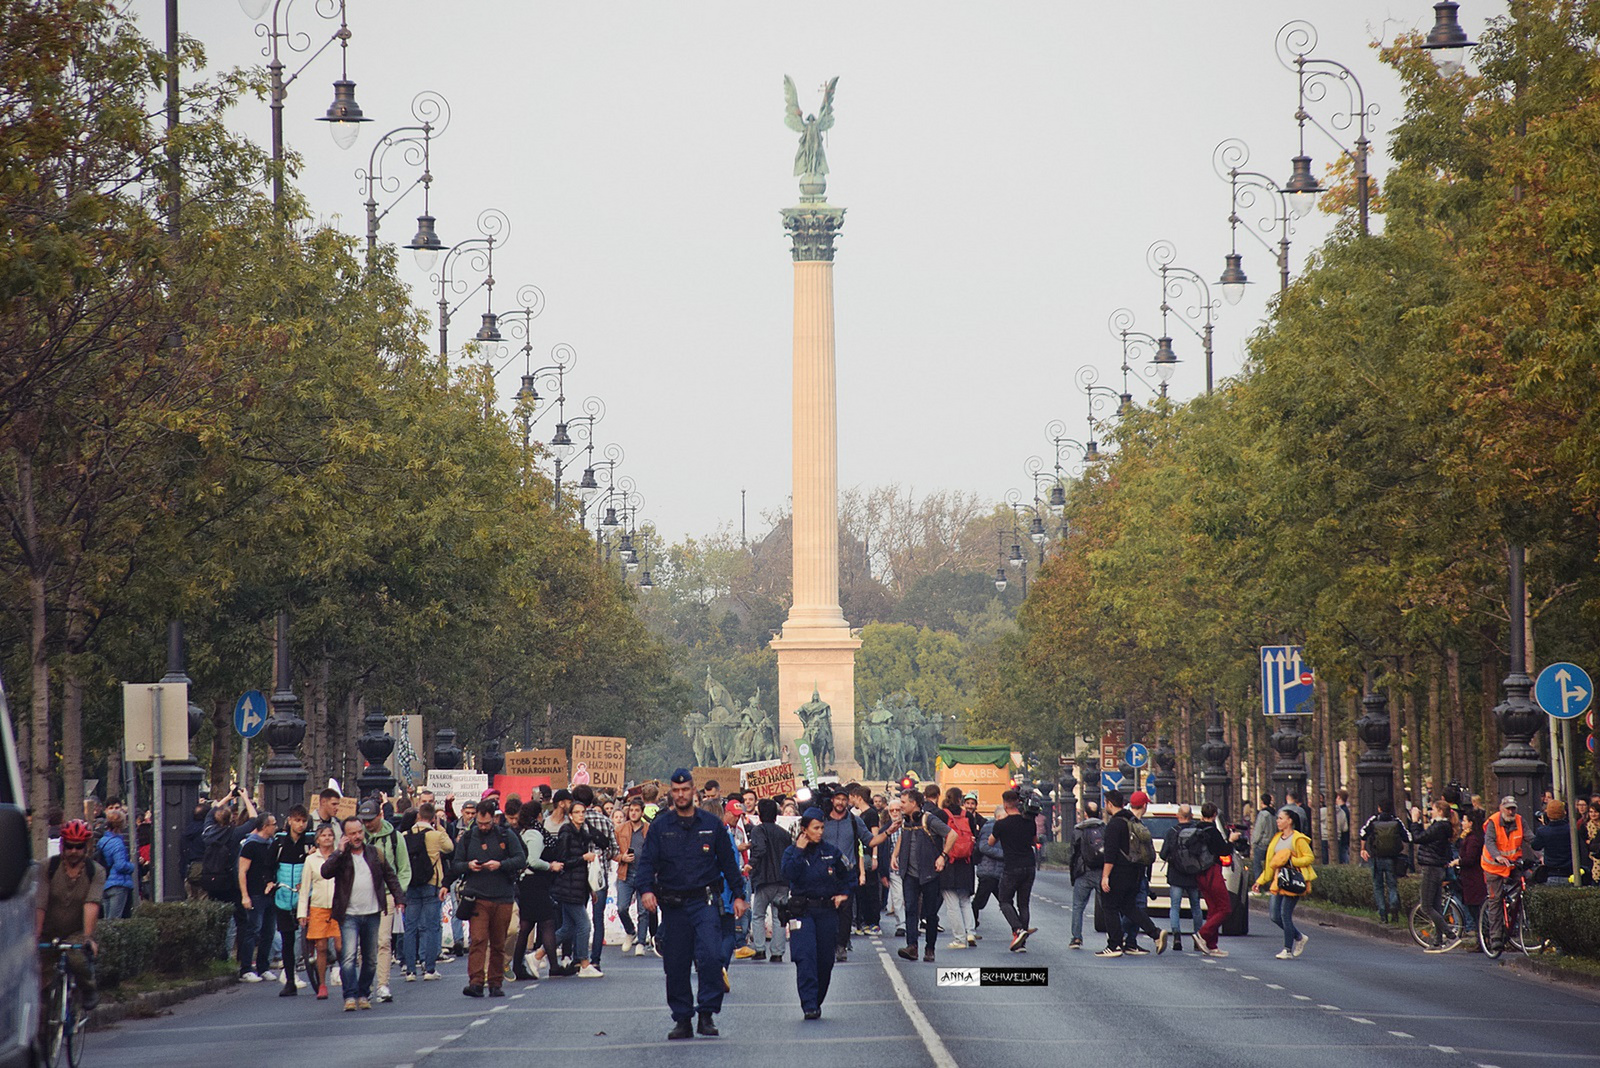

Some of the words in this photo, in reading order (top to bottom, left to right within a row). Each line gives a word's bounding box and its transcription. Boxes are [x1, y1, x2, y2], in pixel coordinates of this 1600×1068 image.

[574, 738, 622, 752] PINTÉR
[747, 771, 756, 780] NE
[953, 768, 999, 778] BAALBEK
